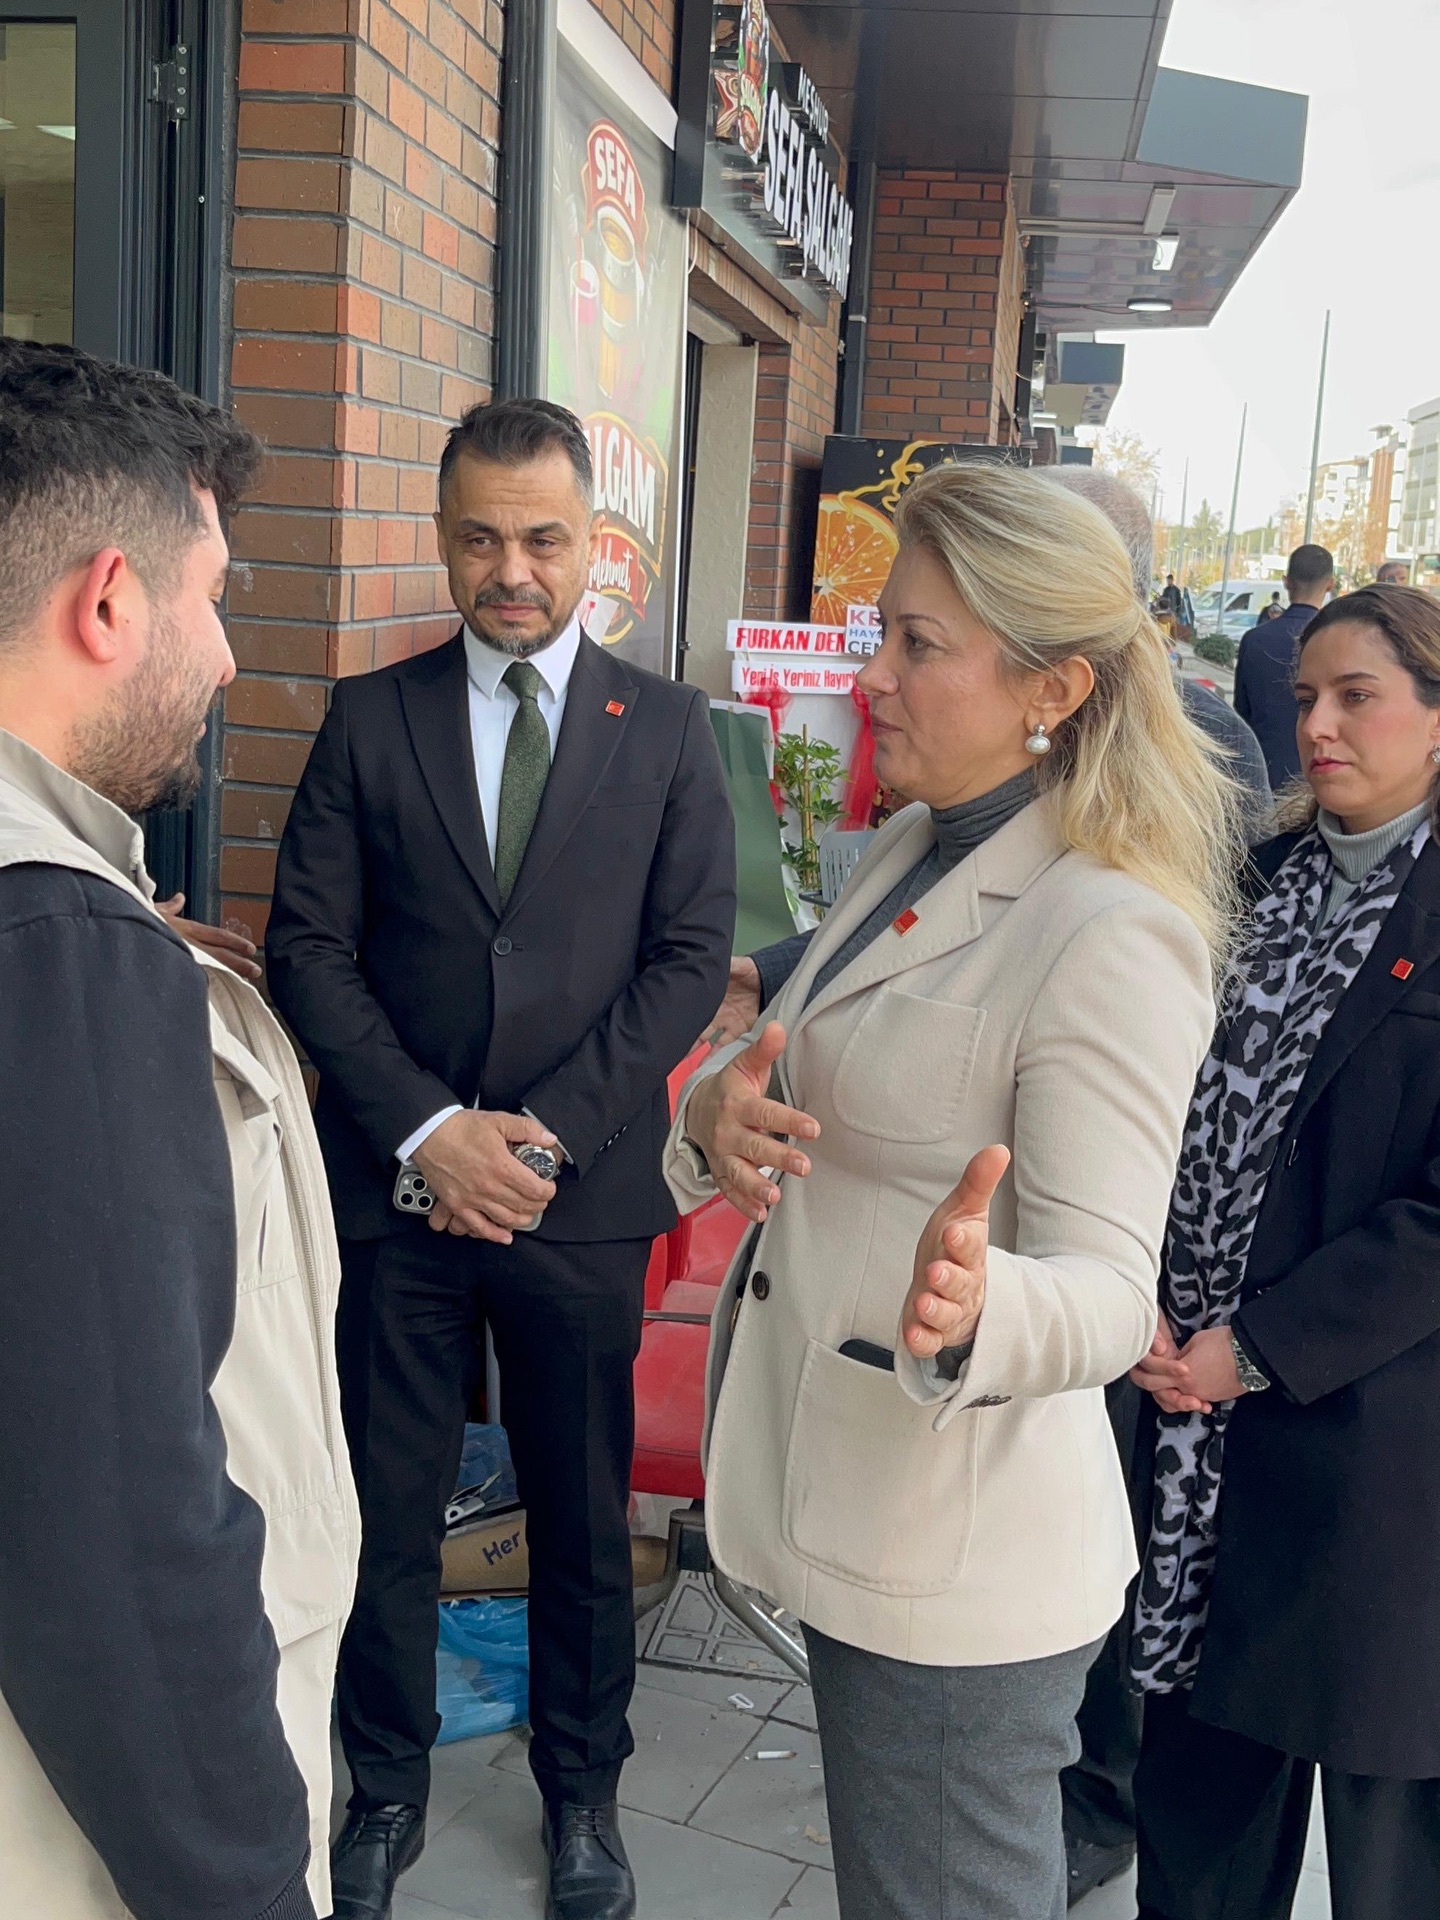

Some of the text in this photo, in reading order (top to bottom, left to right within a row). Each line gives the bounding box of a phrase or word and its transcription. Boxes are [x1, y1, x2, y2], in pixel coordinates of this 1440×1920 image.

[594, 136, 637, 221] SEFA
[764, 89, 854, 300] SEFA ŞALGAM
[583, 425, 656, 546] LGAM
[736, 627, 811, 651] FURKAN
[741, 667, 766, 686] Yeni
[783, 668, 821, 687] Yeriniz
[482, 1531, 520, 1565] Her
